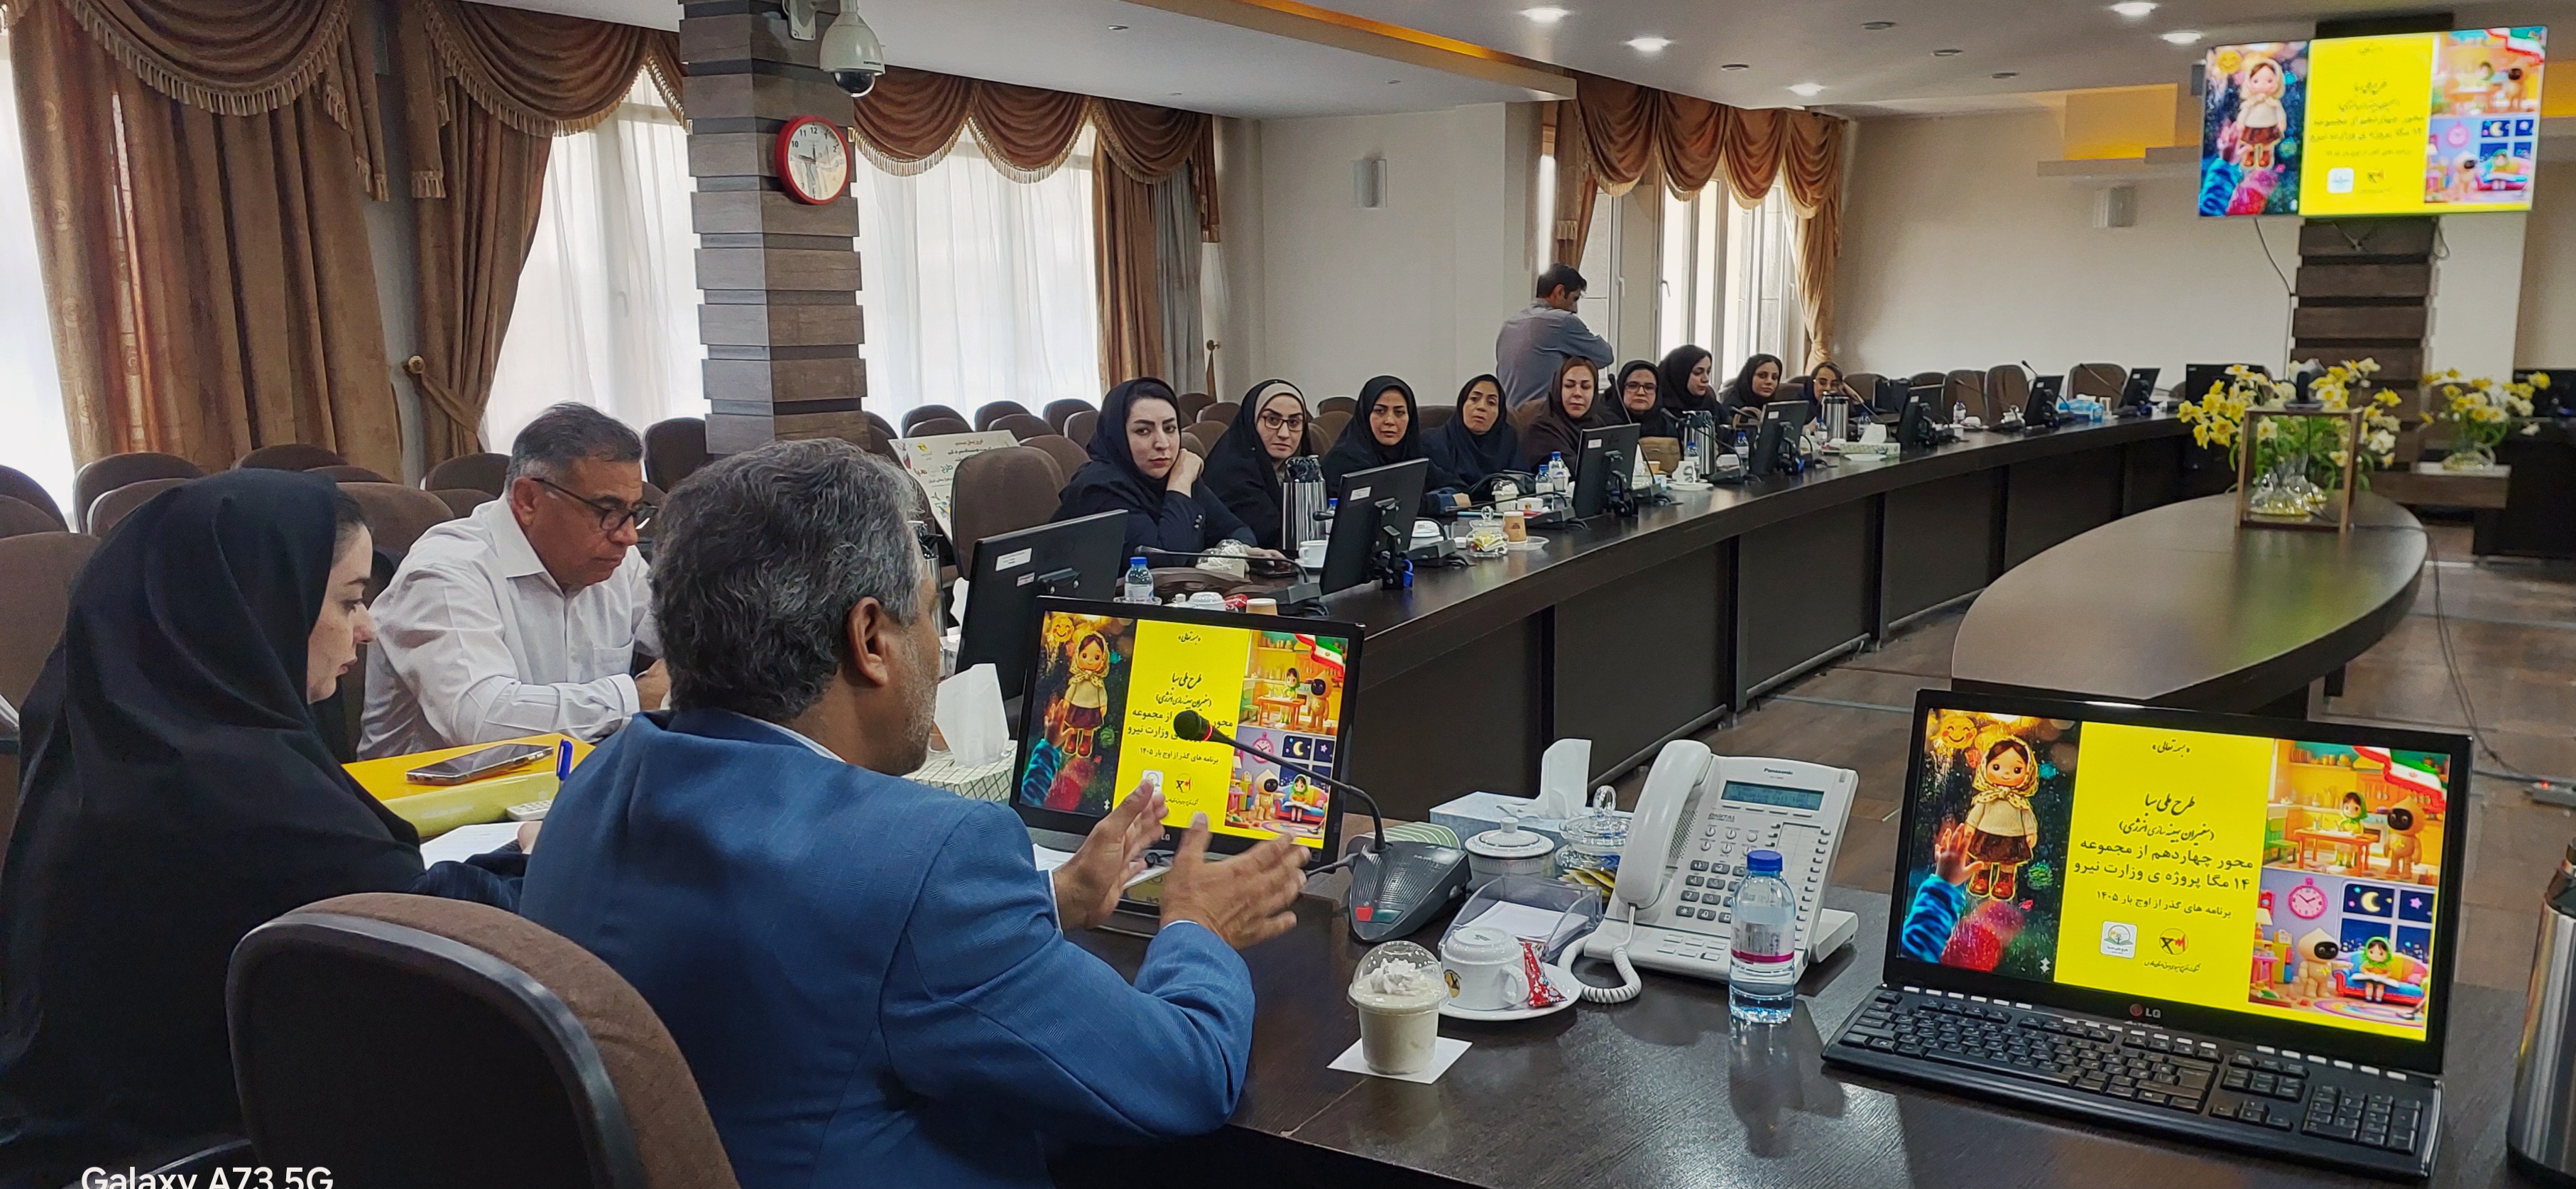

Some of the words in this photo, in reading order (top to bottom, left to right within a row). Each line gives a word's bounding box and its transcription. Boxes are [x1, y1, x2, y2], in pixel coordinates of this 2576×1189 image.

[1179, 672, 1188, 686] ملی
[1186, 673, 1202, 689] طرح
[1132, 709, 1163, 721] مجموعه
[1165, 712, 1173, 722] از
[1128, 726, 1144, 734] نیرو
[1145, 726, 1169, 739] وزارت
[1203, 756, 1219, 765] برنامه
[2144, 793, 2157, 817] سبا
[2156, 793, 2171, 812] ملی
[2171, 796, 2195, 816] طرح
[2080, 839, 2132, 855] مجموعه
[2136, 845, 2148, 859] از
[2151, 849, 2212, 868] چهاردهم
[2216, 855, 2254, 870] محور
[2073, 861, 2100, 874] نیرو
[2104, 863, 2144, 880] وزارت
[2147, 874, 2160, 883] ی
[2165, 871, 2200, 889] پروژه
[2206, 873, 2229, 888] مگا
[2234, 877, 2249, 891] ۱۴
[2096, 890, 2119, 901] ۱۴۰۵
[2121, 894, 2133, 905] بار
[2135, 898, 2151, 908] اوج
[2153, 898, 2161, 908] از
[2163, 900, 2182, 911] گذر
[2183, 903, 2203, 914] های
[2205, 904, 2232, 918] برنامه
[2146, 1007, 2161, 1019] LG
